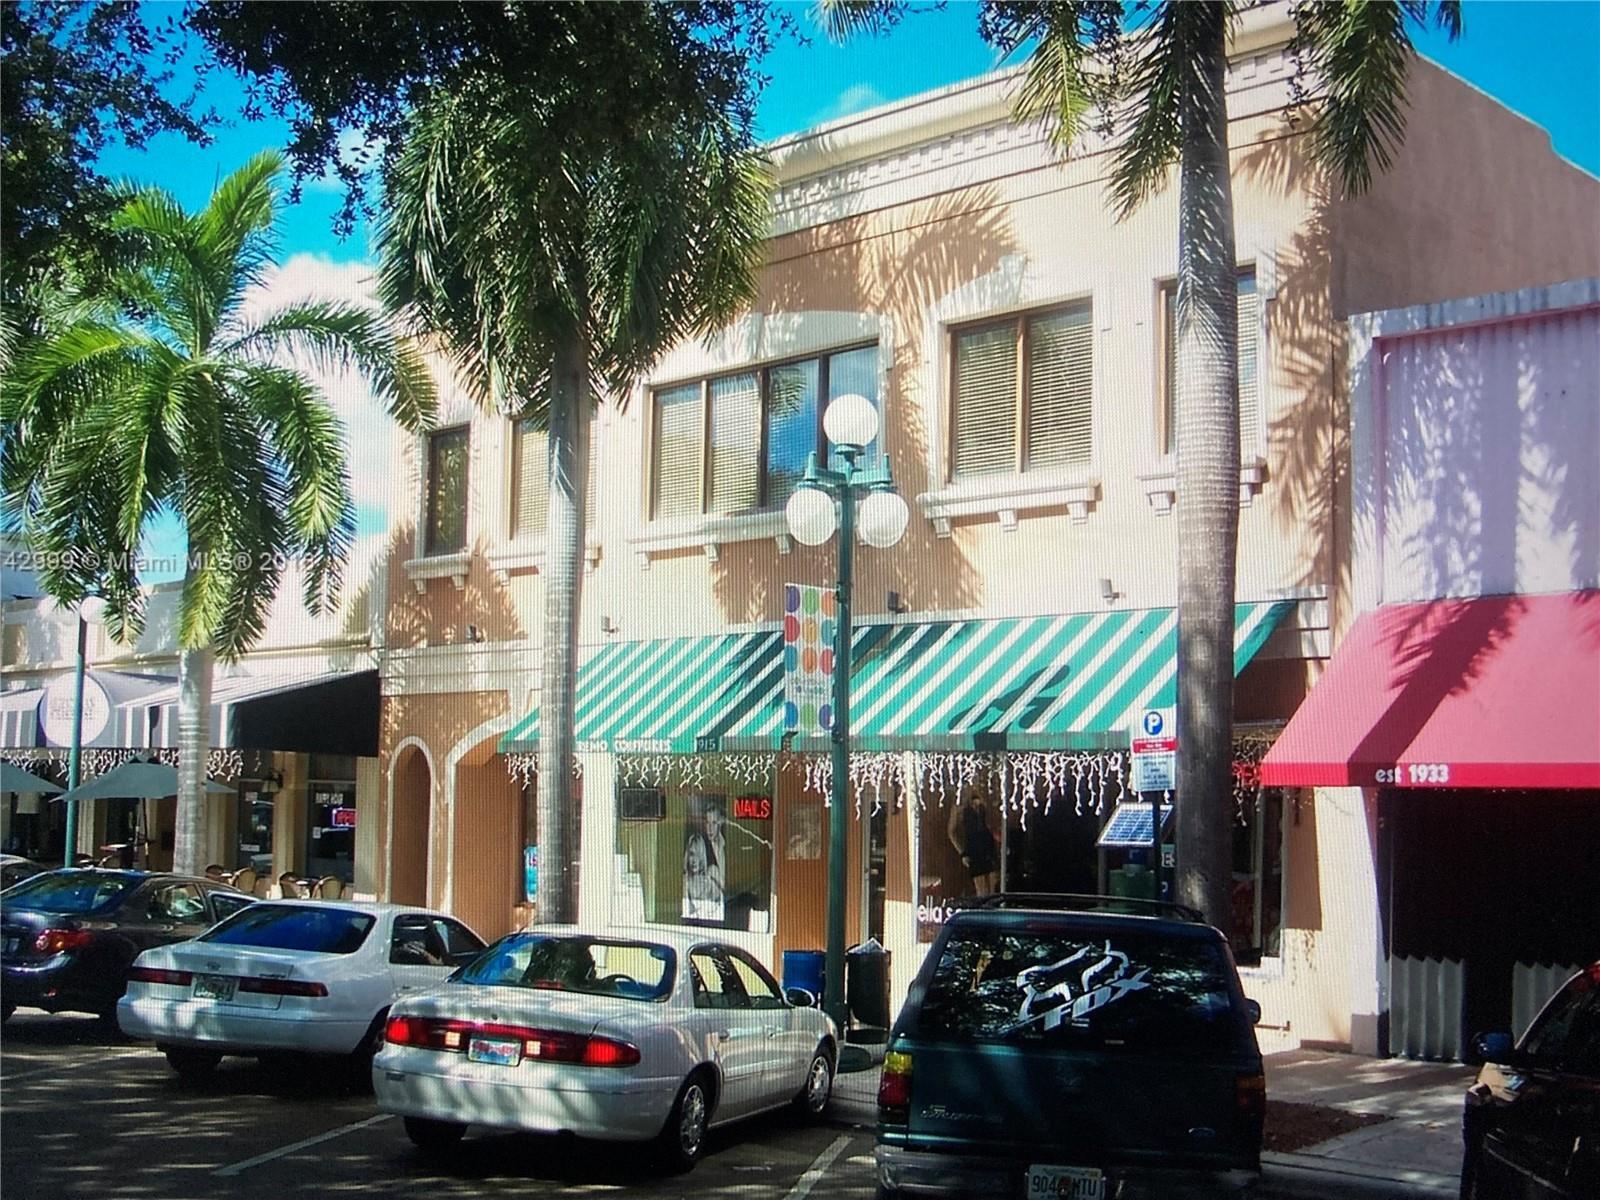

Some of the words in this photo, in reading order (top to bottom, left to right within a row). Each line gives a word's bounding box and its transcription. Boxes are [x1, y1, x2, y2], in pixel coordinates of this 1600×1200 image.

[698, 738, 716, 751] 915
[1375, 764, 1402, 784] est
[1408, 763, 1449, 784] 1933
[733, 799, 770, 818] NAILS
